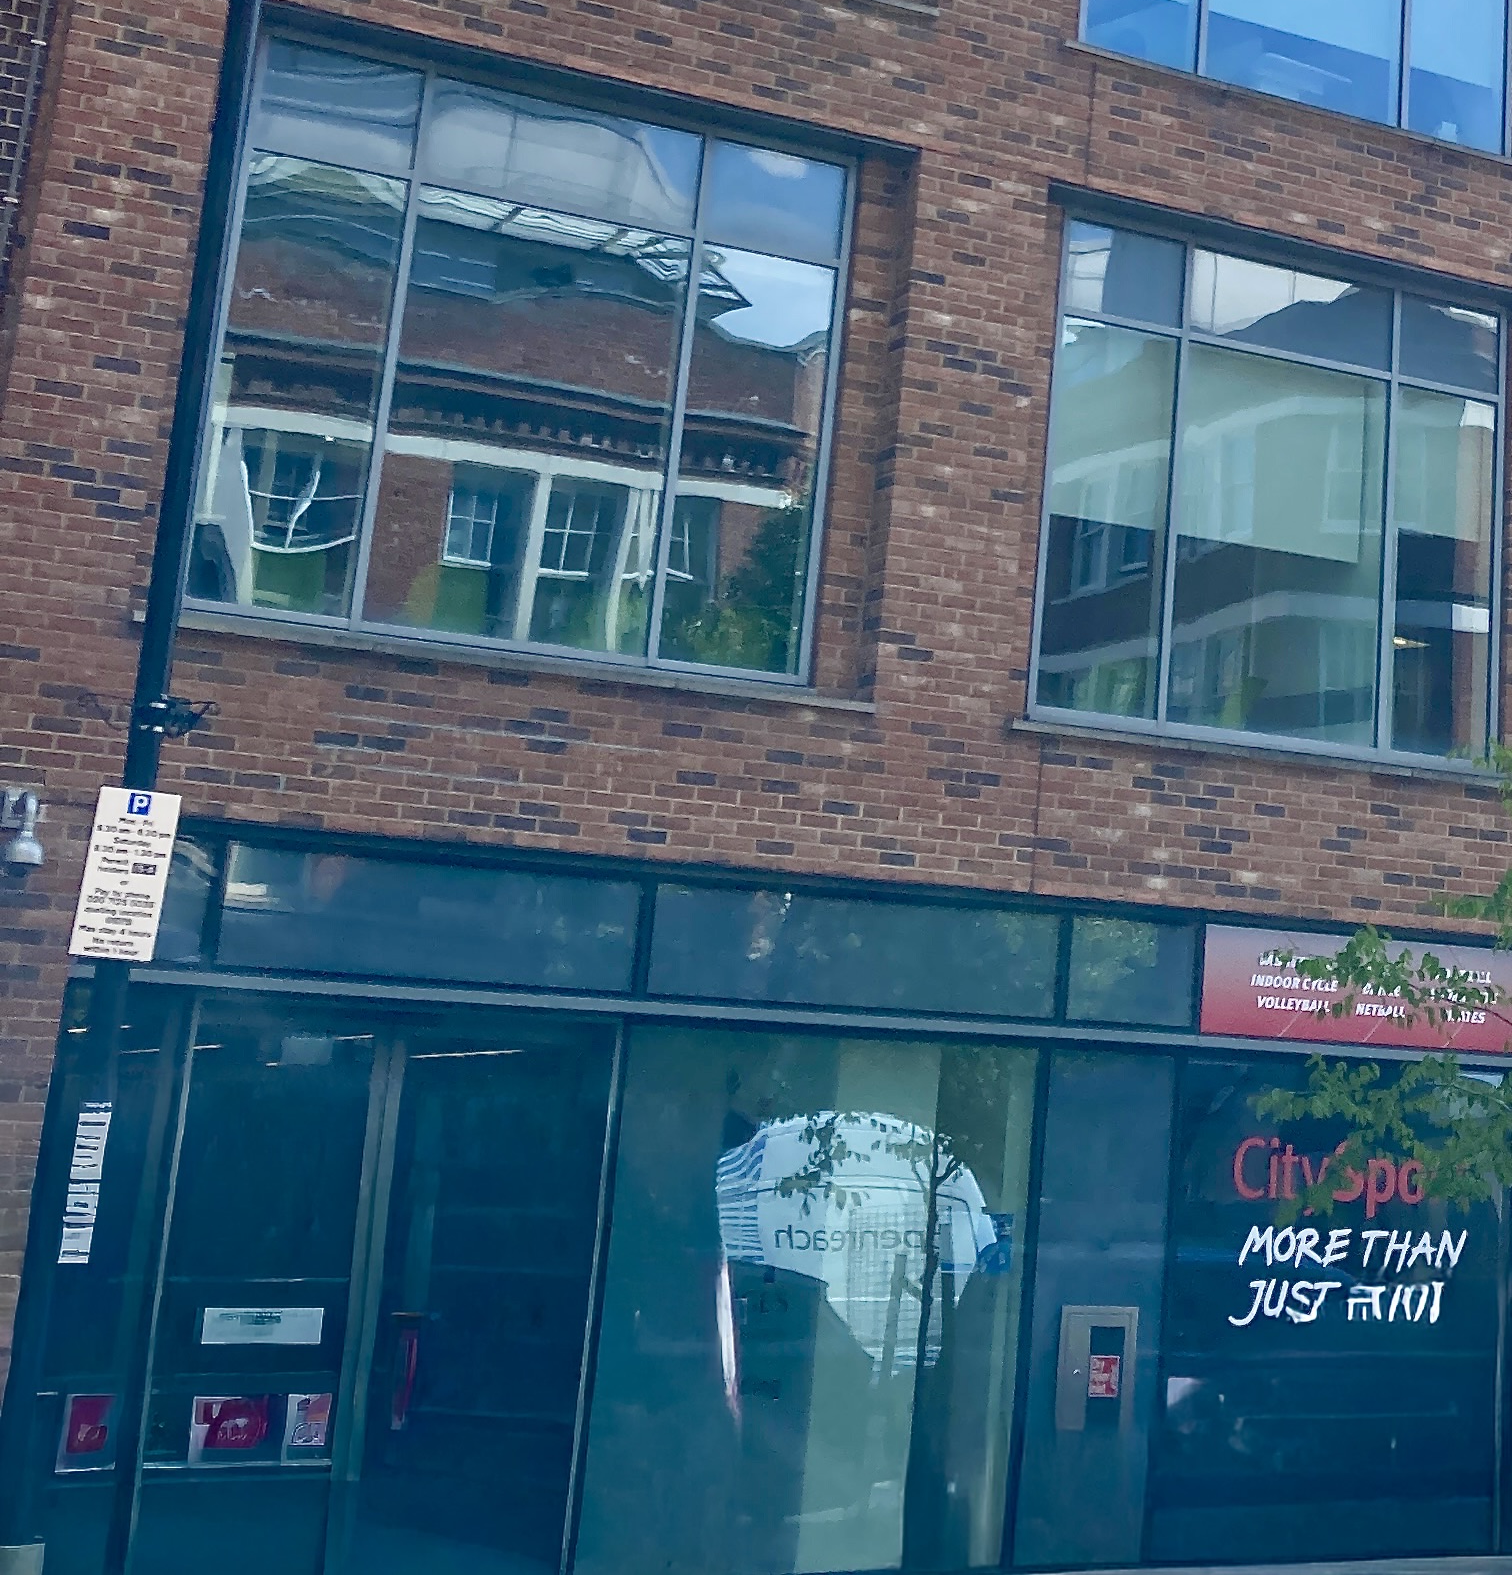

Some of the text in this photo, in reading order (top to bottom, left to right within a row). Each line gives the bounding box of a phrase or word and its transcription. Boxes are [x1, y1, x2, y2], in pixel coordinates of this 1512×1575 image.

[1250, 974, 1300, 989] INDOOR
[1233, 1136, 1460, 1220] CitySpo
[1237, 1225, 1469, 1274] MORE THAN
[1227, 1278, 1343, 1326] JUST
